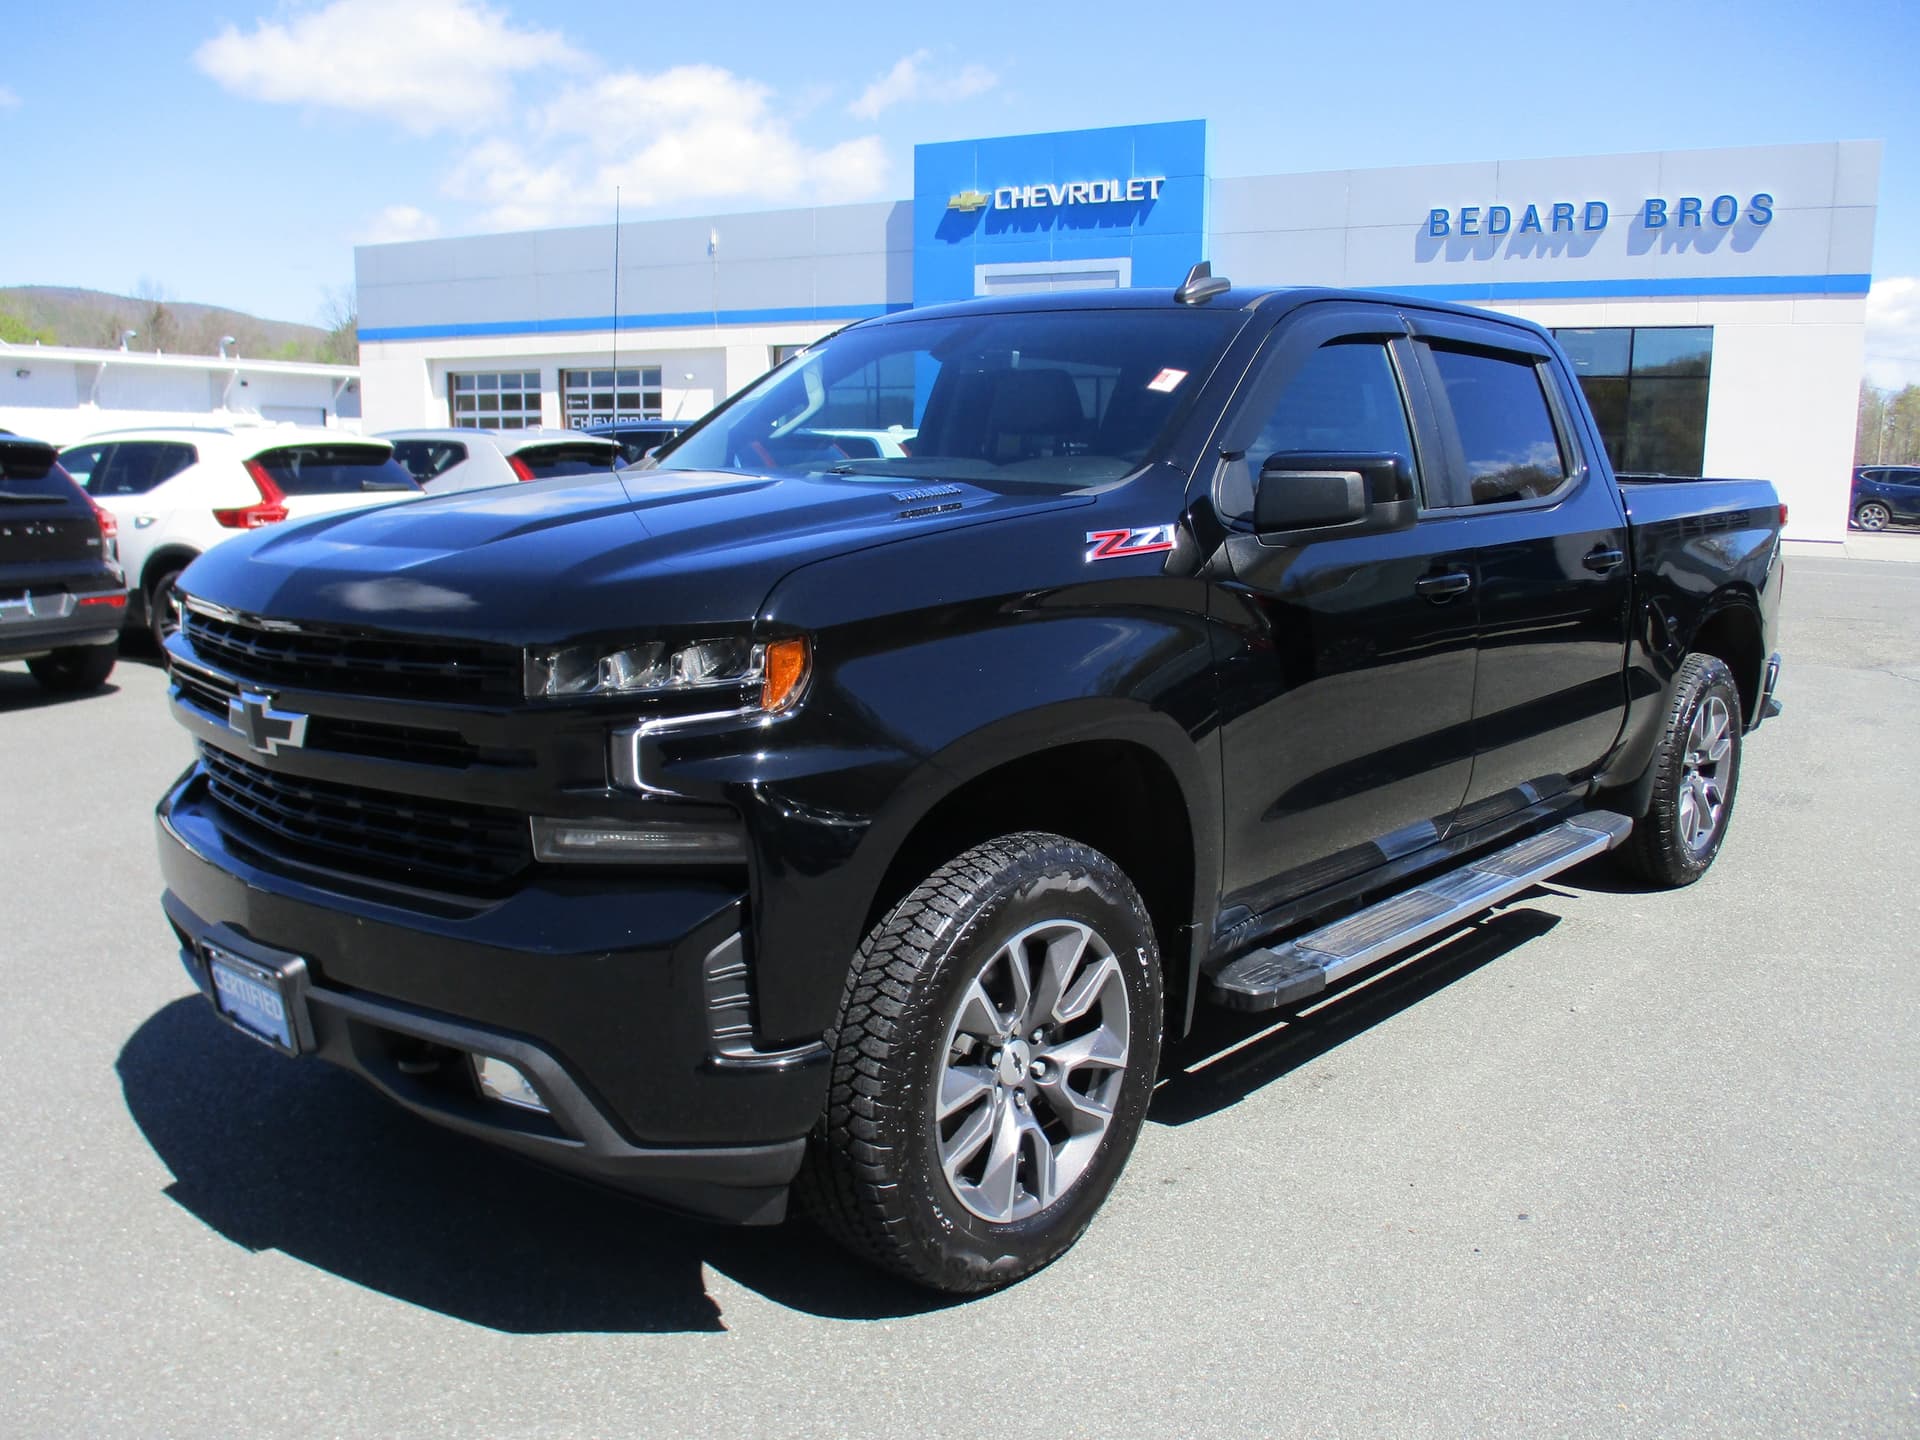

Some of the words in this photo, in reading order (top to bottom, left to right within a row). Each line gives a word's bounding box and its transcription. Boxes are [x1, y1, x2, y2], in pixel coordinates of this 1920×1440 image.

[994, 176, 1166, 210] CHEVROLET
[1428, 201, 1609, 237] BEDARD
[1644, 193, 1774, 229] BROS
[1086, 524, 1176, 562] Z71
